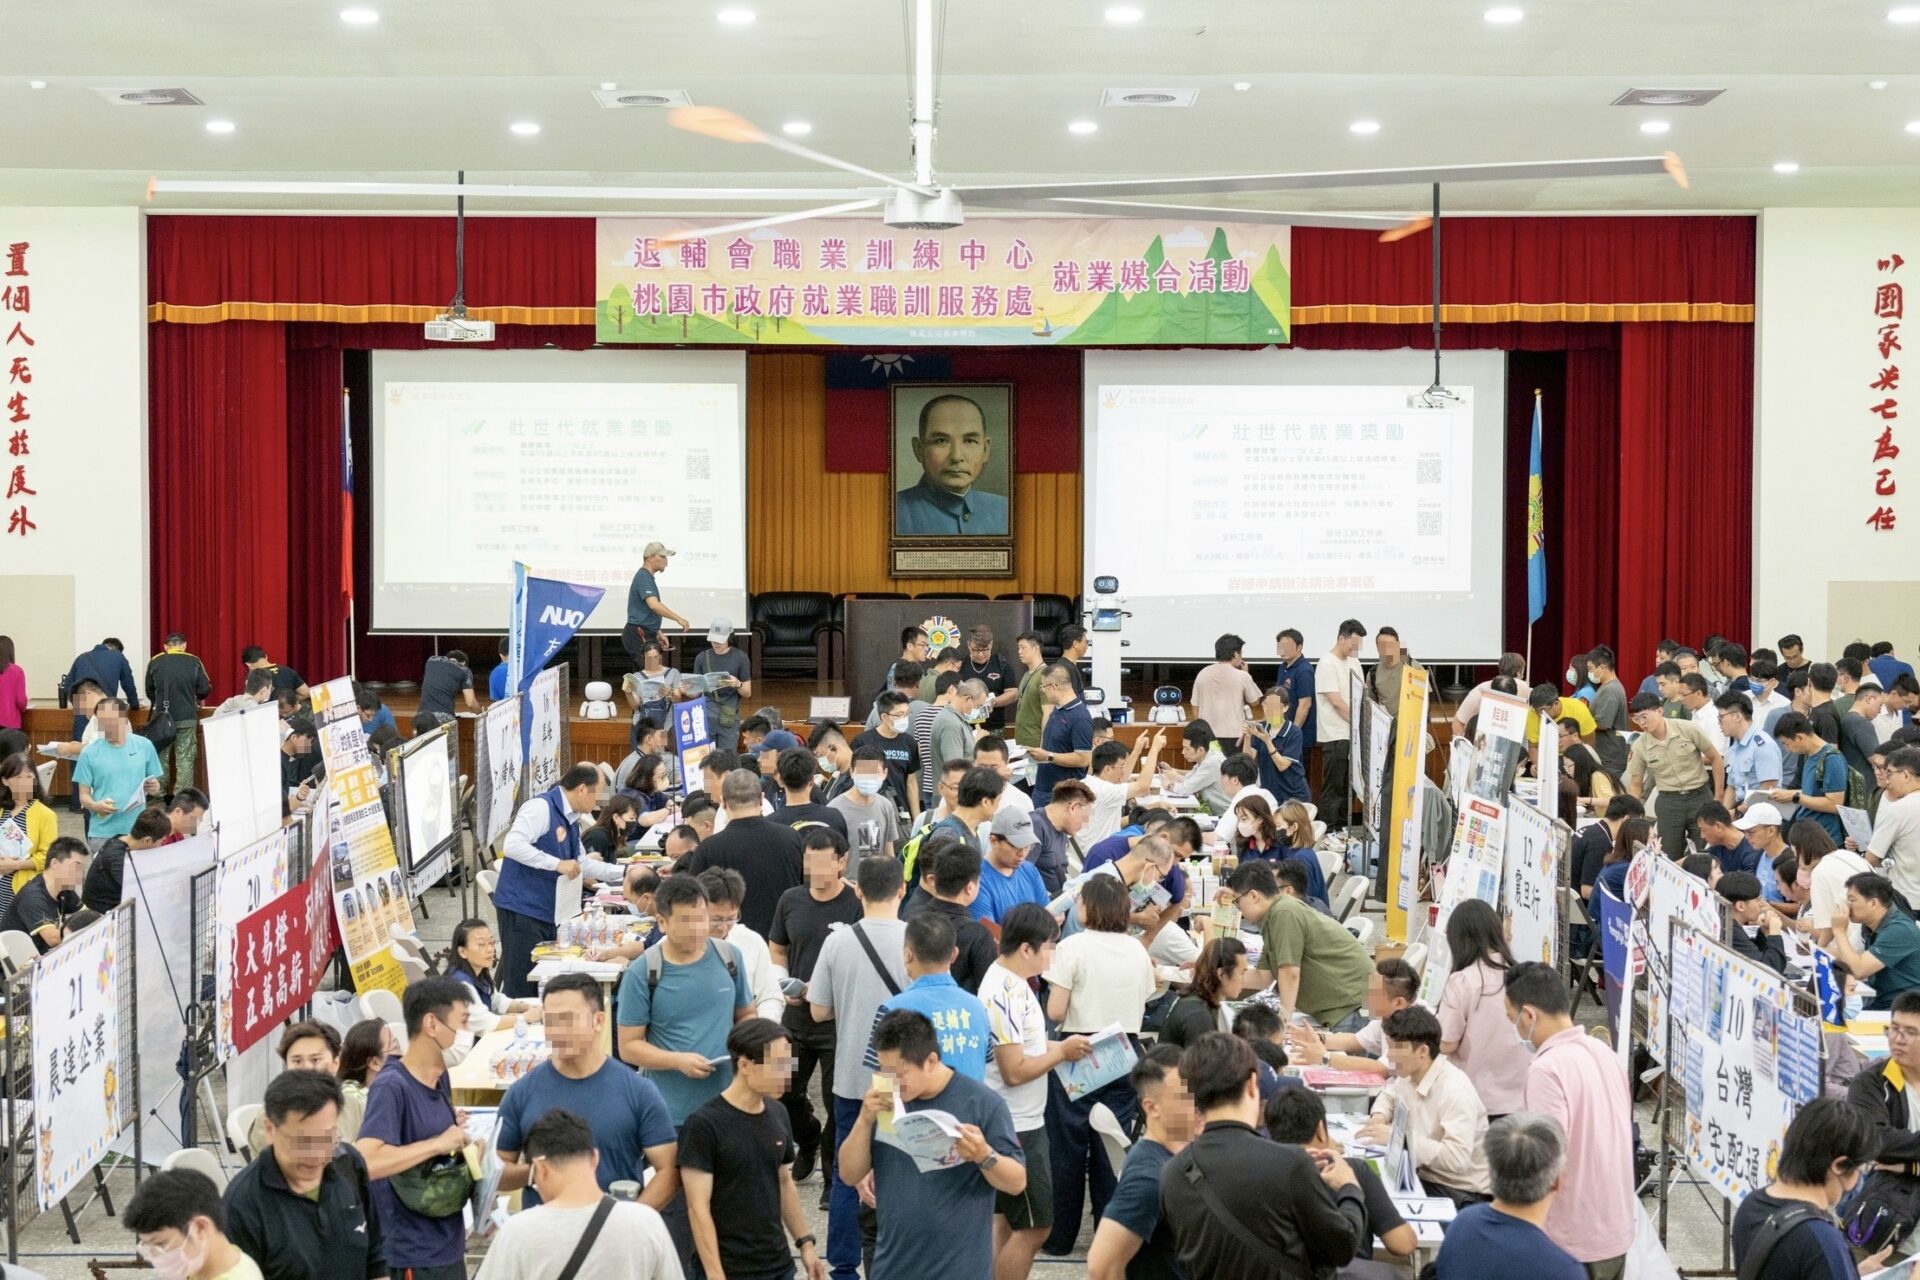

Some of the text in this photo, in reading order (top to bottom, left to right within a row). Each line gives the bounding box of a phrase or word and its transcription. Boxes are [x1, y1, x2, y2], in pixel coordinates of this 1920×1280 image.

[632, 237, 1035, 273] 退輔會職業訓練中心
[1052, 257, 1251, 295] 就業媒合活動
[631, 282, 1034, 318] 桃園市政府就業職訓服務處
[1231, 423, 1405, 442] 壯世代就業獎勵
[1523, 836, 1532, 868] 12
[247, 874, 260, 912] 20
[69, 973, 84, 1020] 21
[1726, 994, 1745, 1041] 10
[939, 1033, 980, 1055] 訓中心
[1715, 1054, 1754, 1121] 台灣
[1708, 1115, 1760, 1192] 宅配通
